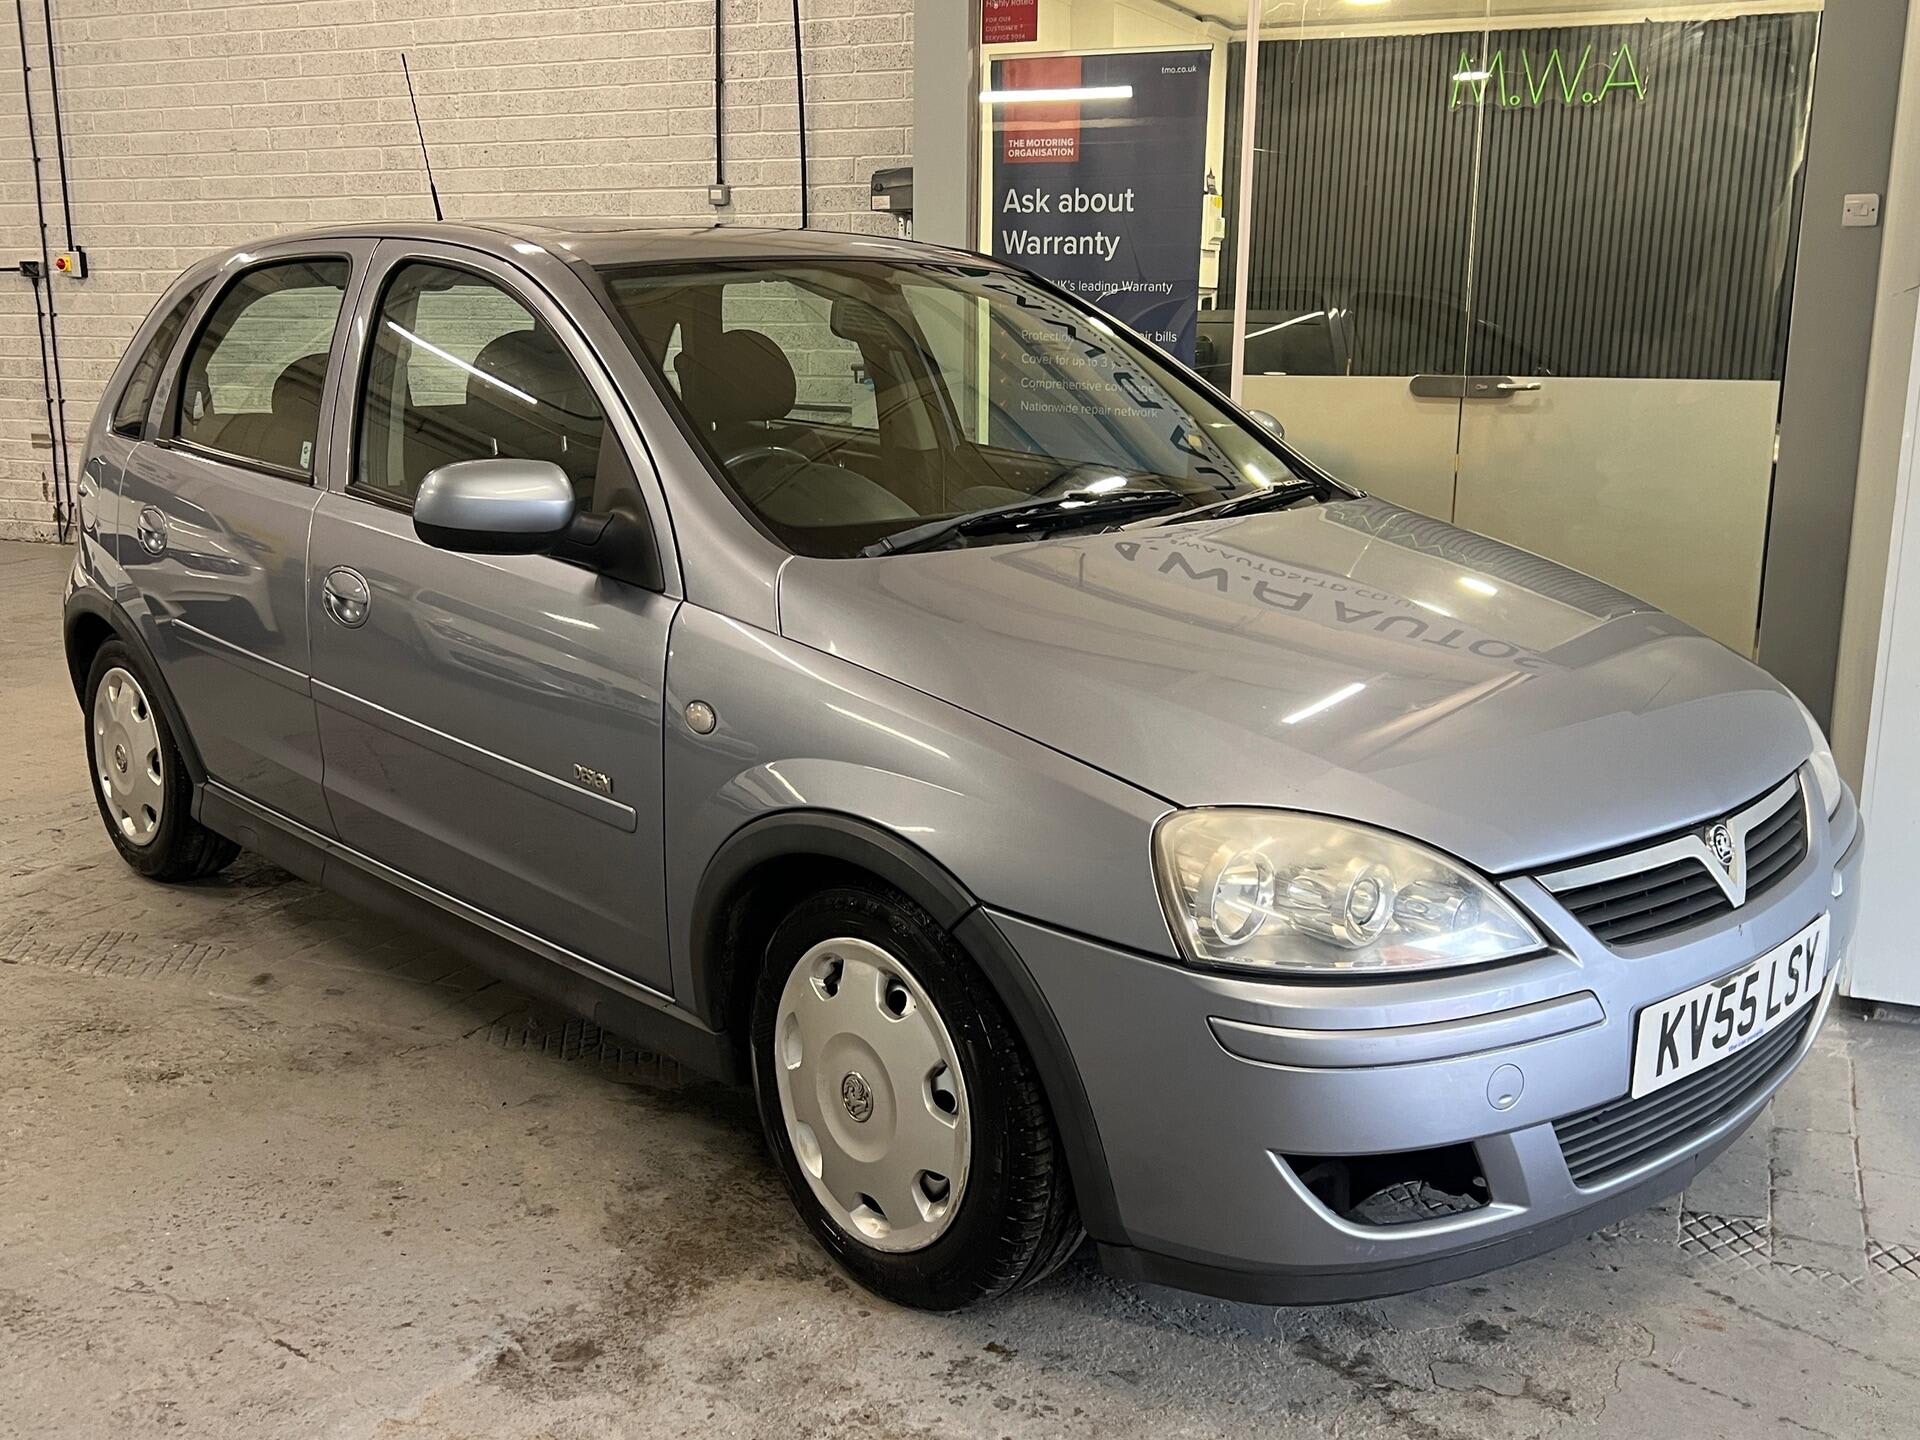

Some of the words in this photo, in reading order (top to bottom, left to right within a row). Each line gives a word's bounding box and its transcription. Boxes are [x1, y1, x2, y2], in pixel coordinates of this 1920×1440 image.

[1451, 43, 1644, 107] M.W.A
[1008, 139, 1025, 148] THE
[1026, 138, 1074, 147] MOTORING
[1008, 147, 1074, 158] ORGANISATION
[1002, 188, 1050, 213] Ask
[1058, 187, 1134, 213] about
[1002, 230, 1120, 261] Warranty
[1078, 280, 1119, 293] leading
[1122, 280, 1173, 295] Warranty
[1155, 330, 1177, 342] bills
[1021, 353, 1052, 365] Cover
[1055, 354, 1070, 366] for
[1072, 357, 1085, 368] up
[1088, 356, 1098, 367] to
[1100, 357, 1108, 368] 3
[1021, 377, 1102, 391] Comprehensive
[1104, 383, 1155, 396] covge
[1021, 401, 1078, 414] Nationwide
[1081, 402, 1112, 416] repair
[1114, 404, 1158, 418] network
[573, 763, 613, 795] DESIGN
[1655, 970, 1760, 1078] KV55
[1765, 931, 1821, 1022] LSY
